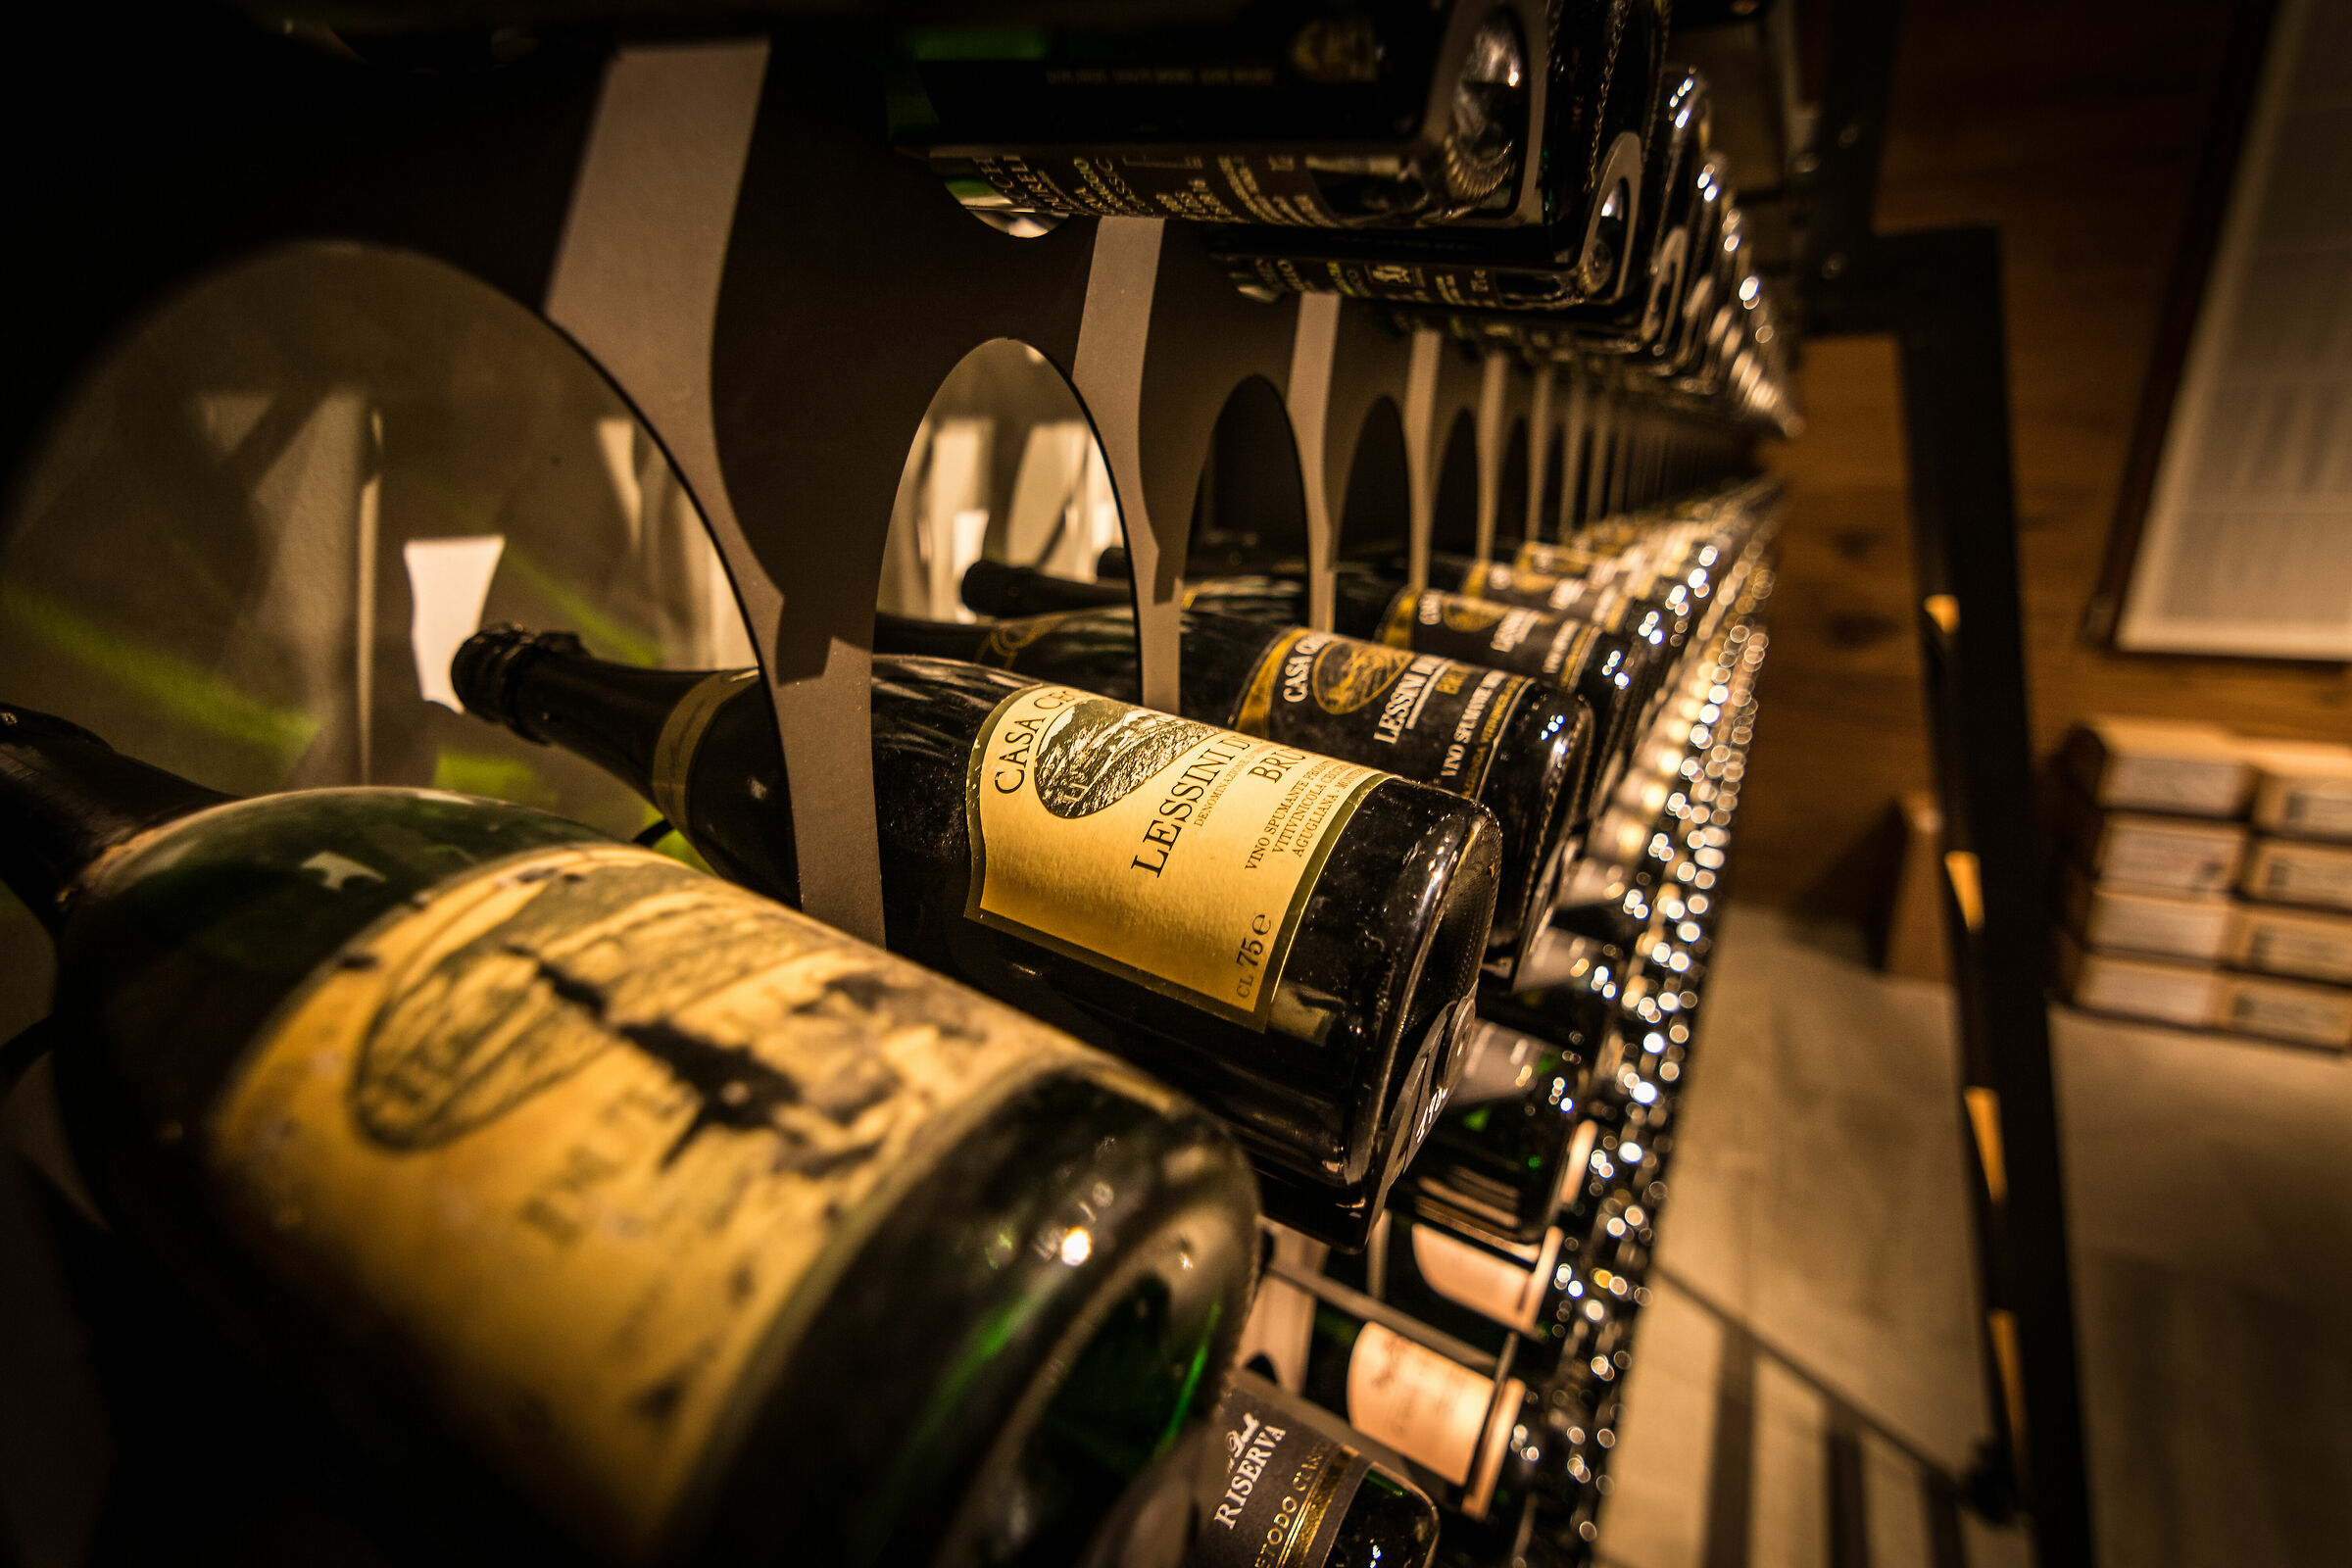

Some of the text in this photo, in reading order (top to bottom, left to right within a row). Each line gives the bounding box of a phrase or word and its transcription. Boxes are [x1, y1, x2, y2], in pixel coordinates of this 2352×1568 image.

[995, 717, 1047, 794] CASA
[1248, 749, 1305, 784] BRU
[1130, 749, 1236, 878] LESSINI
[1245, 837, 1270, 870] VINO
[1263, 780, 1309, 835] SPUMANTE
[1272, 784, 1327, 854] VITIVINICOLA
[1292, 794, 1339, 858] AGUGLIANA
[1236, 974, 1253, 998] CL
[1237, 937, 1263, 966] 75
[1214, 1426, 1286, 1530] RISERVA
[1253, 1495, 1298, 1568] ETODO
